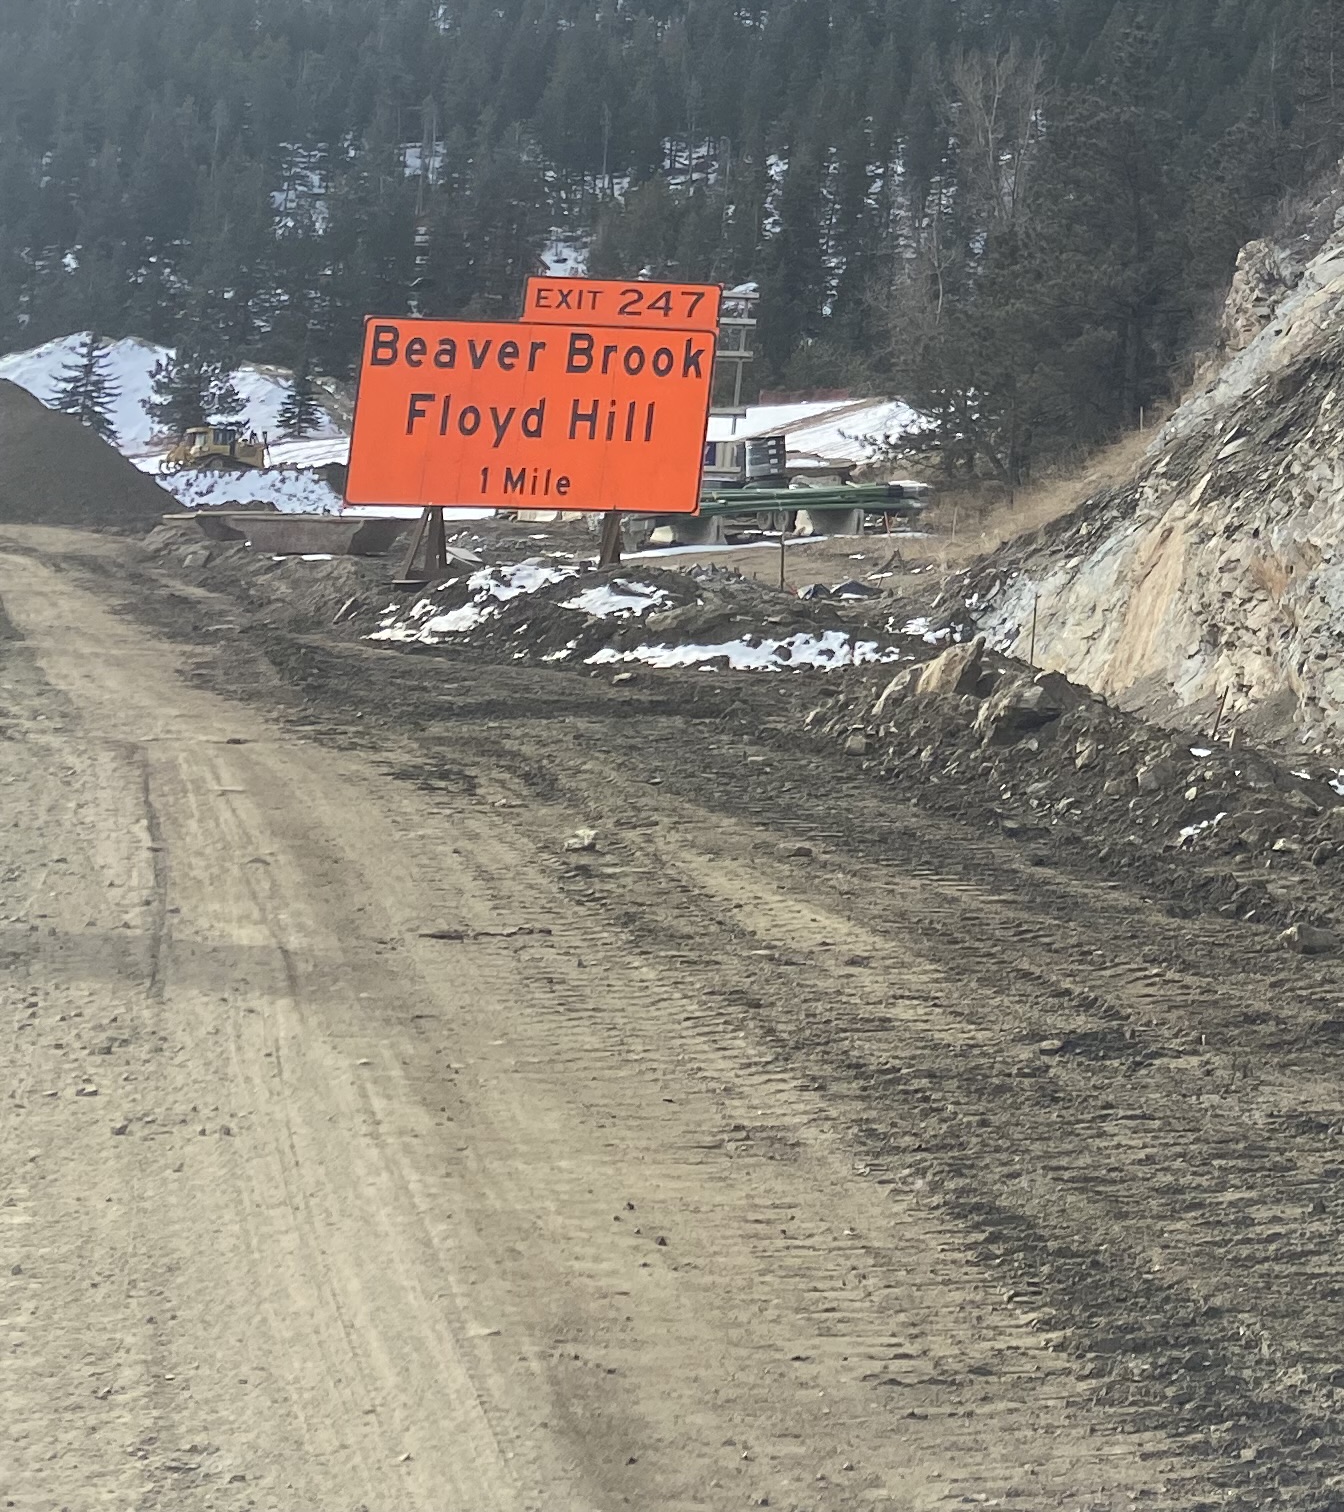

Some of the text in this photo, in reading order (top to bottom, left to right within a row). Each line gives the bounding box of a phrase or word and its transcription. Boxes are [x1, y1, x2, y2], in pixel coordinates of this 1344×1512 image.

[535, 288, 705, 318] EXIT 247
[370, 325, 705, 378] Beaver Brook
[405, 393, 655, 448] Floyd Hill
[481, 467, 571, 496] 1 Mile
